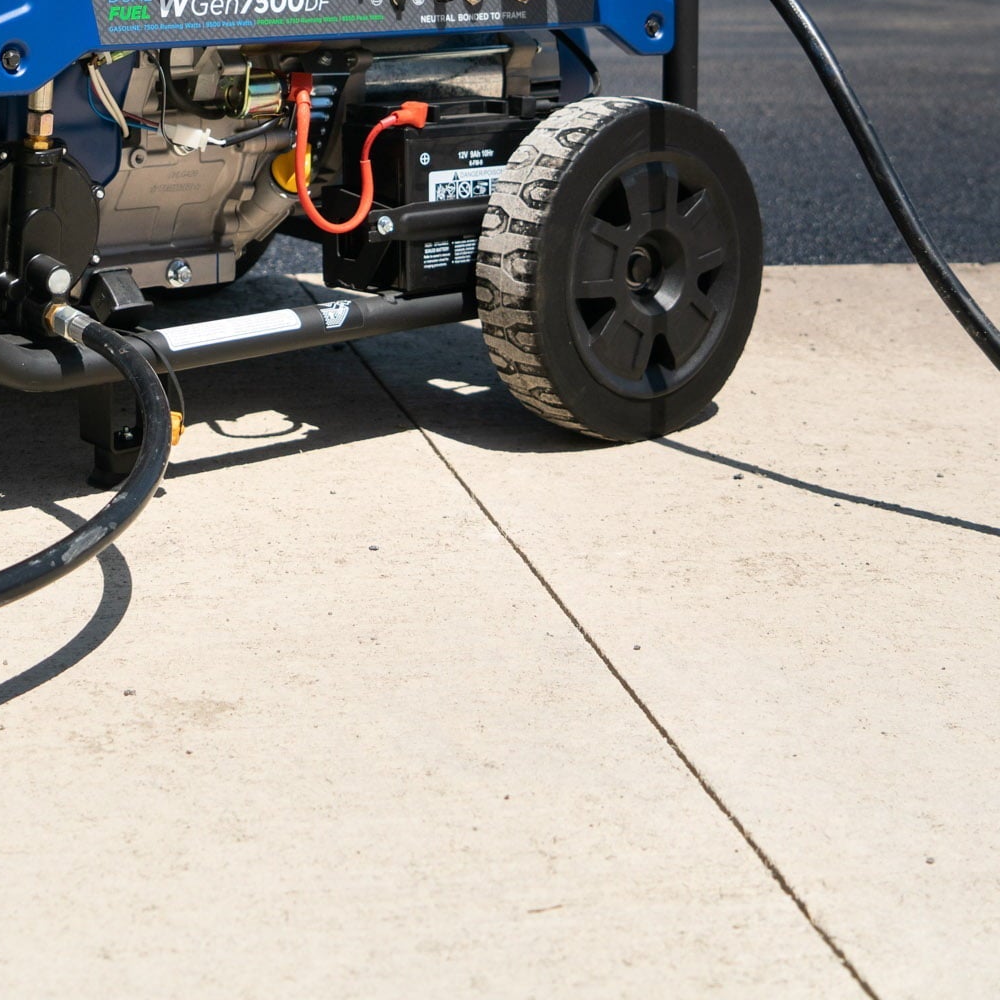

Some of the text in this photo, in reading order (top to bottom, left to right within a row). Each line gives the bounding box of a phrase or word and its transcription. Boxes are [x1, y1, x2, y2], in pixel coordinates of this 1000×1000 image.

[108, 5, 151, 20] FUEL
[420, 10, 527, 24] NEUTRAL BONDED TO FRAME
[458, 151, 468, 159] 12V
